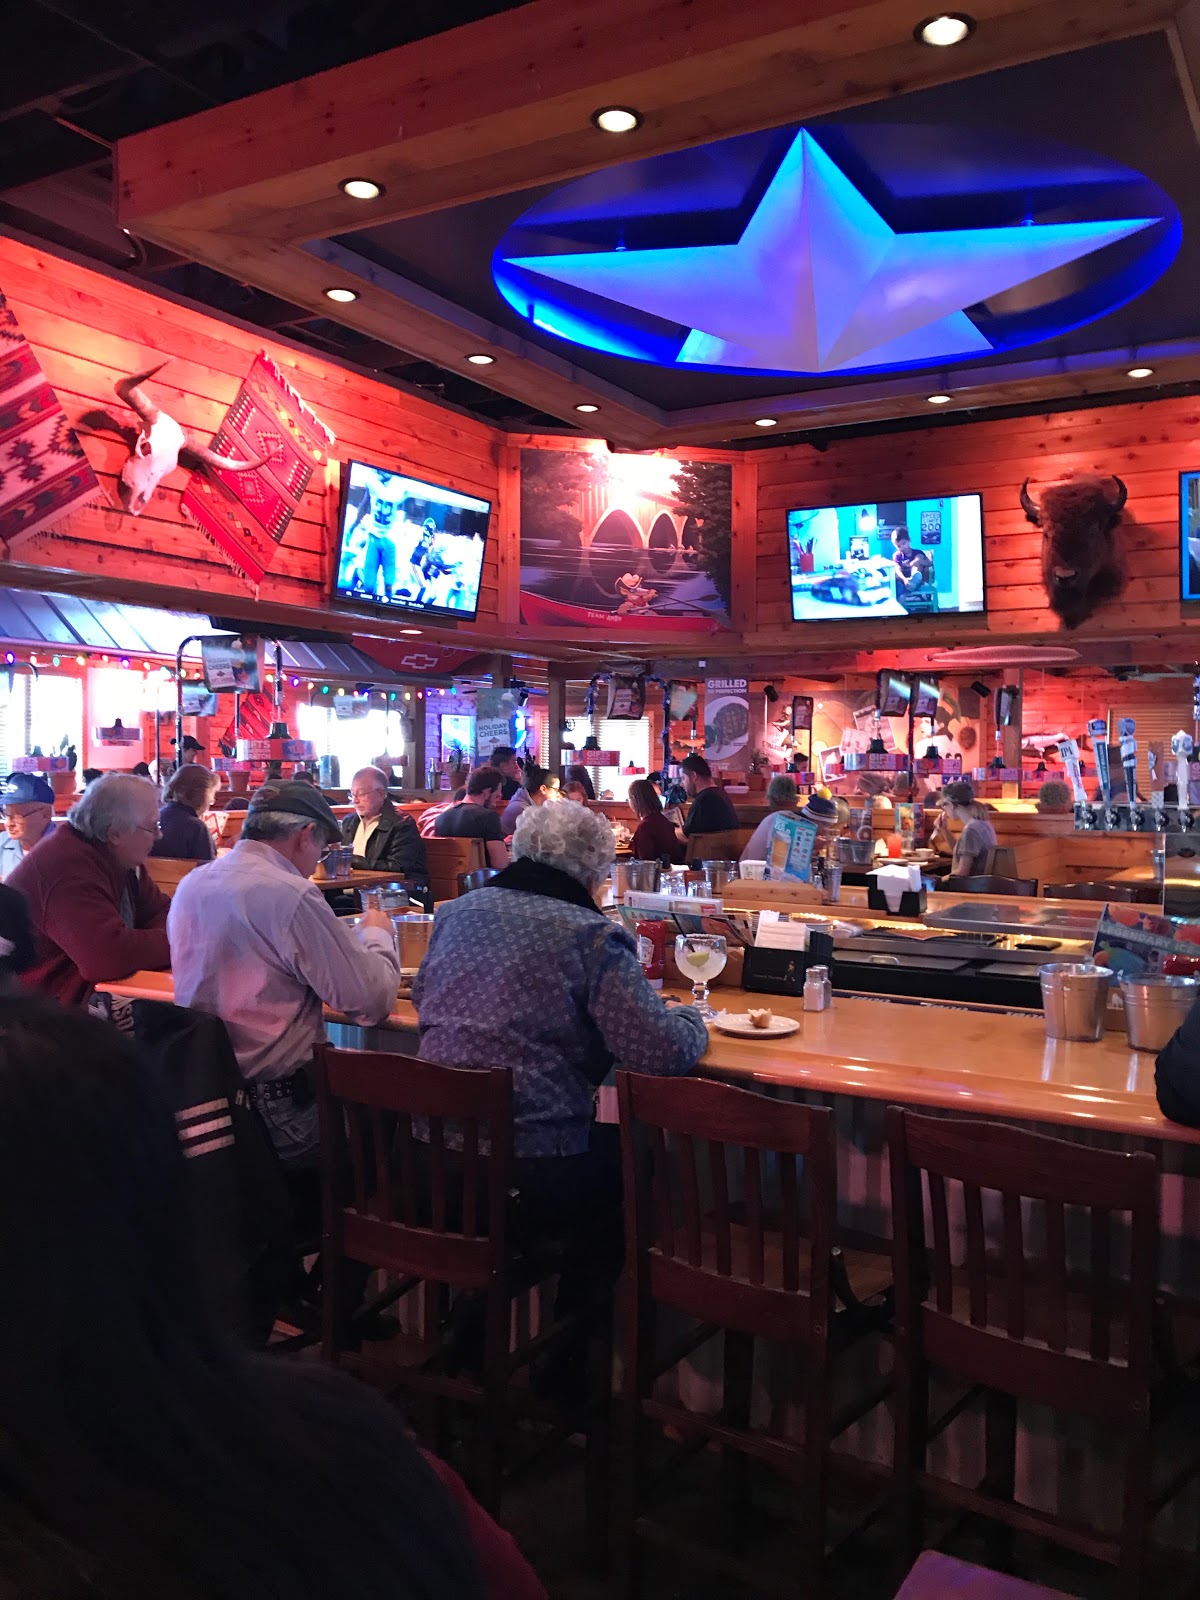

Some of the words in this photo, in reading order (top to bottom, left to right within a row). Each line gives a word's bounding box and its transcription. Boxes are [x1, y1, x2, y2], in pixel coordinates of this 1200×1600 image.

[921, 523, 941, 531] 200
[587, 611, 605, 619] TEAM
[707, 679, 747, 689] GRILLED
[478, 722, 508, 732] HOLIDAY
[479, 728, 508, 738] CHEERS
[247, 740, 271, 749] IFTS
[1100, 923, 1171, 948] LEGENDARY
